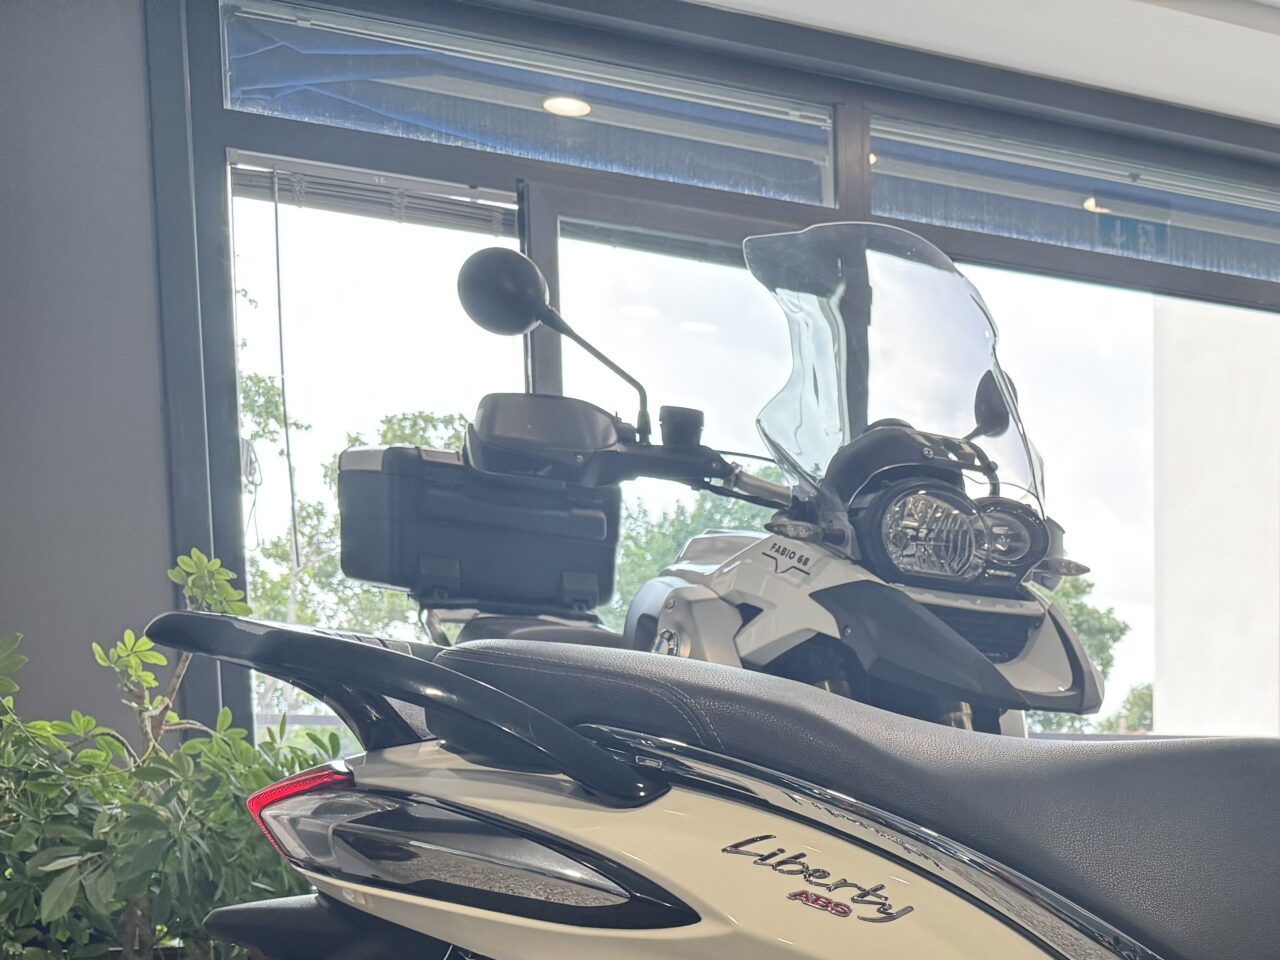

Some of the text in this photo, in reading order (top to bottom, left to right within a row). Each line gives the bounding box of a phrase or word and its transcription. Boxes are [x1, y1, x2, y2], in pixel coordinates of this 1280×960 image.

[770, 543, 796, 560] FABIO
[721, 834, 914, 923] Liberty
[786, 889, 852, 918] ABS
